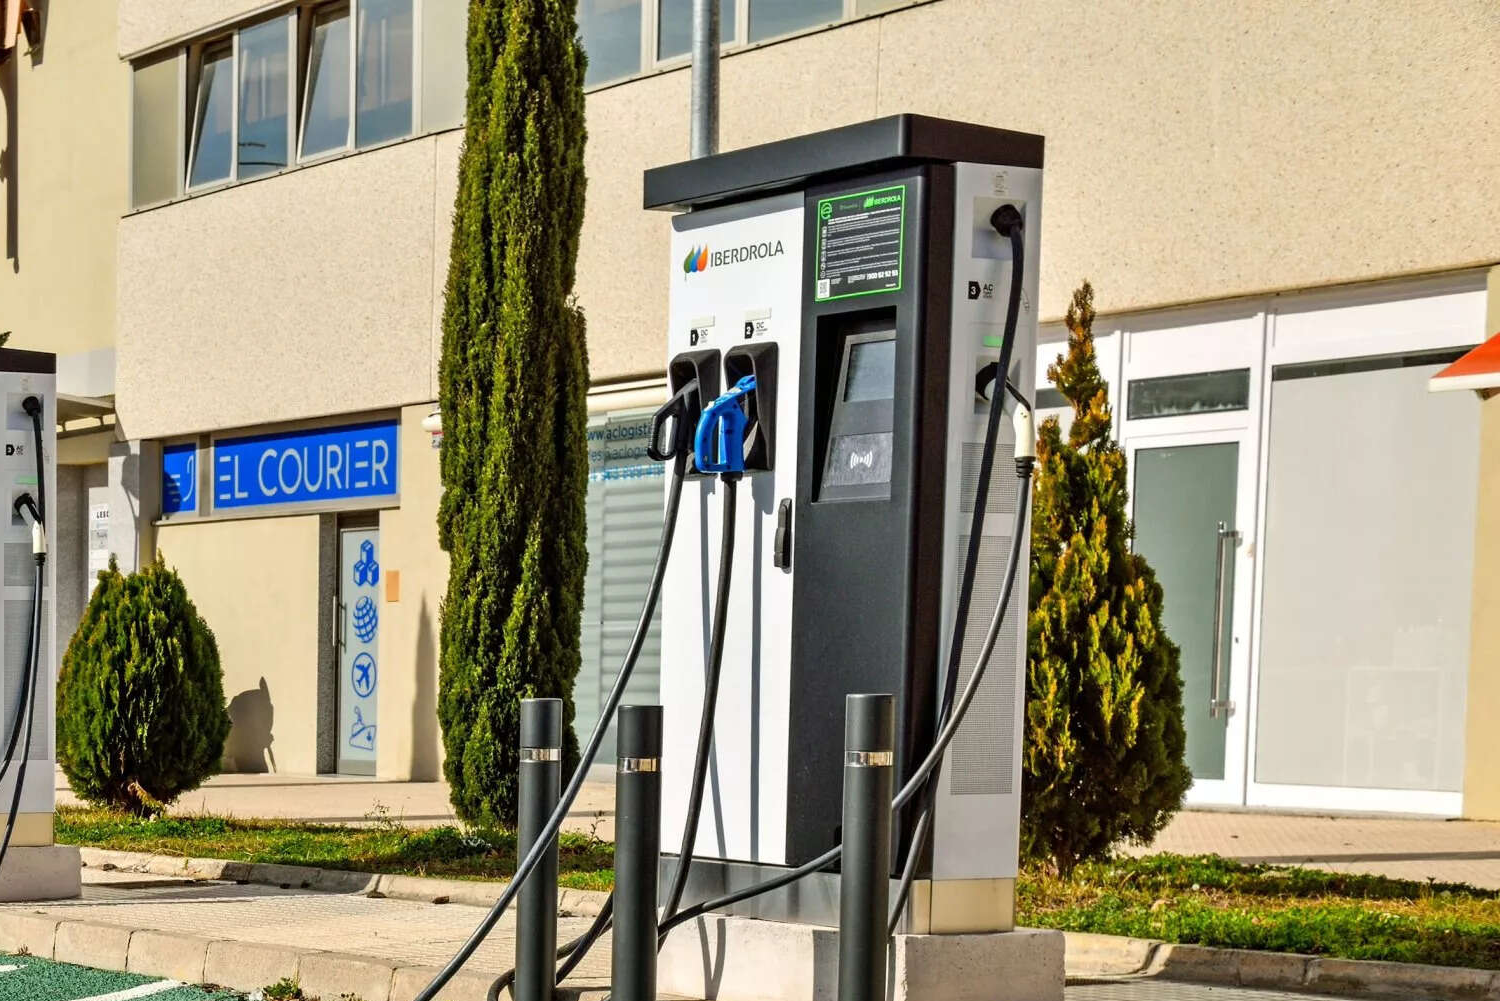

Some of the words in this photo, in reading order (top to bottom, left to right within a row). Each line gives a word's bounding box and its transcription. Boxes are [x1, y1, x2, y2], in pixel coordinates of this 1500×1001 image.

[710, 240, 784, 268] IBERDROLA
[970, 286, 976, 295] 3
[219, 455, 248, 500] EL
[258, 439, 389, 497] COURIER
